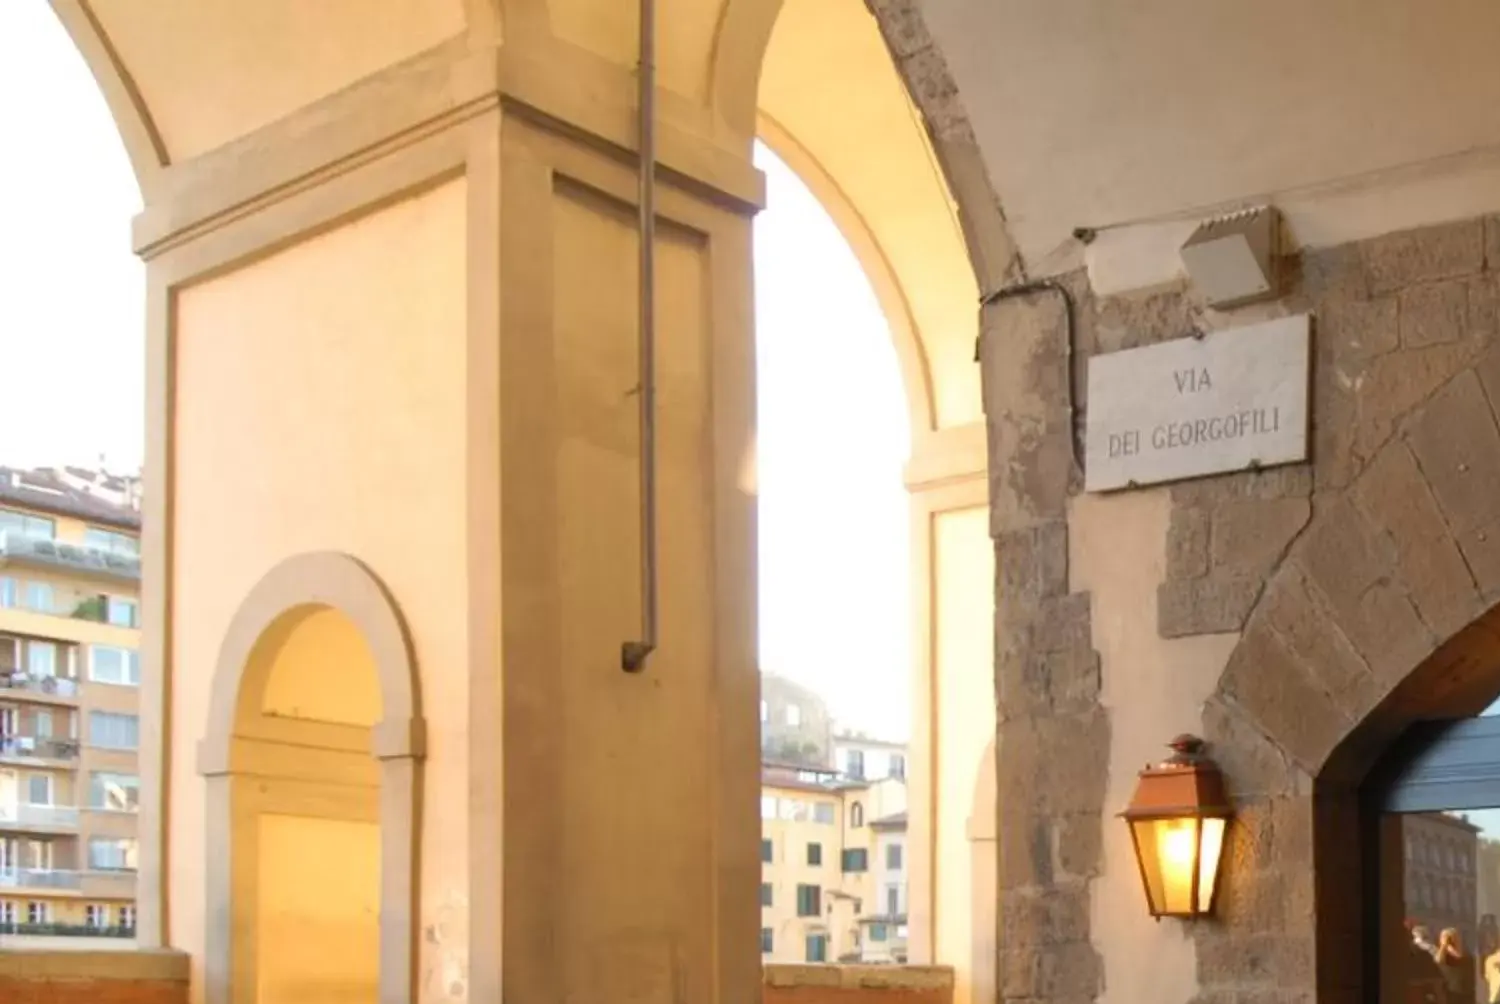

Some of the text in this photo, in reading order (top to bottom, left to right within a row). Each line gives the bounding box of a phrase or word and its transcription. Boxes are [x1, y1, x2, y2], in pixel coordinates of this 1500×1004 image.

[1172, 367, 1212, 394] VIA
[1108, 407, 1280, 458] DEI GEORGOFILI
